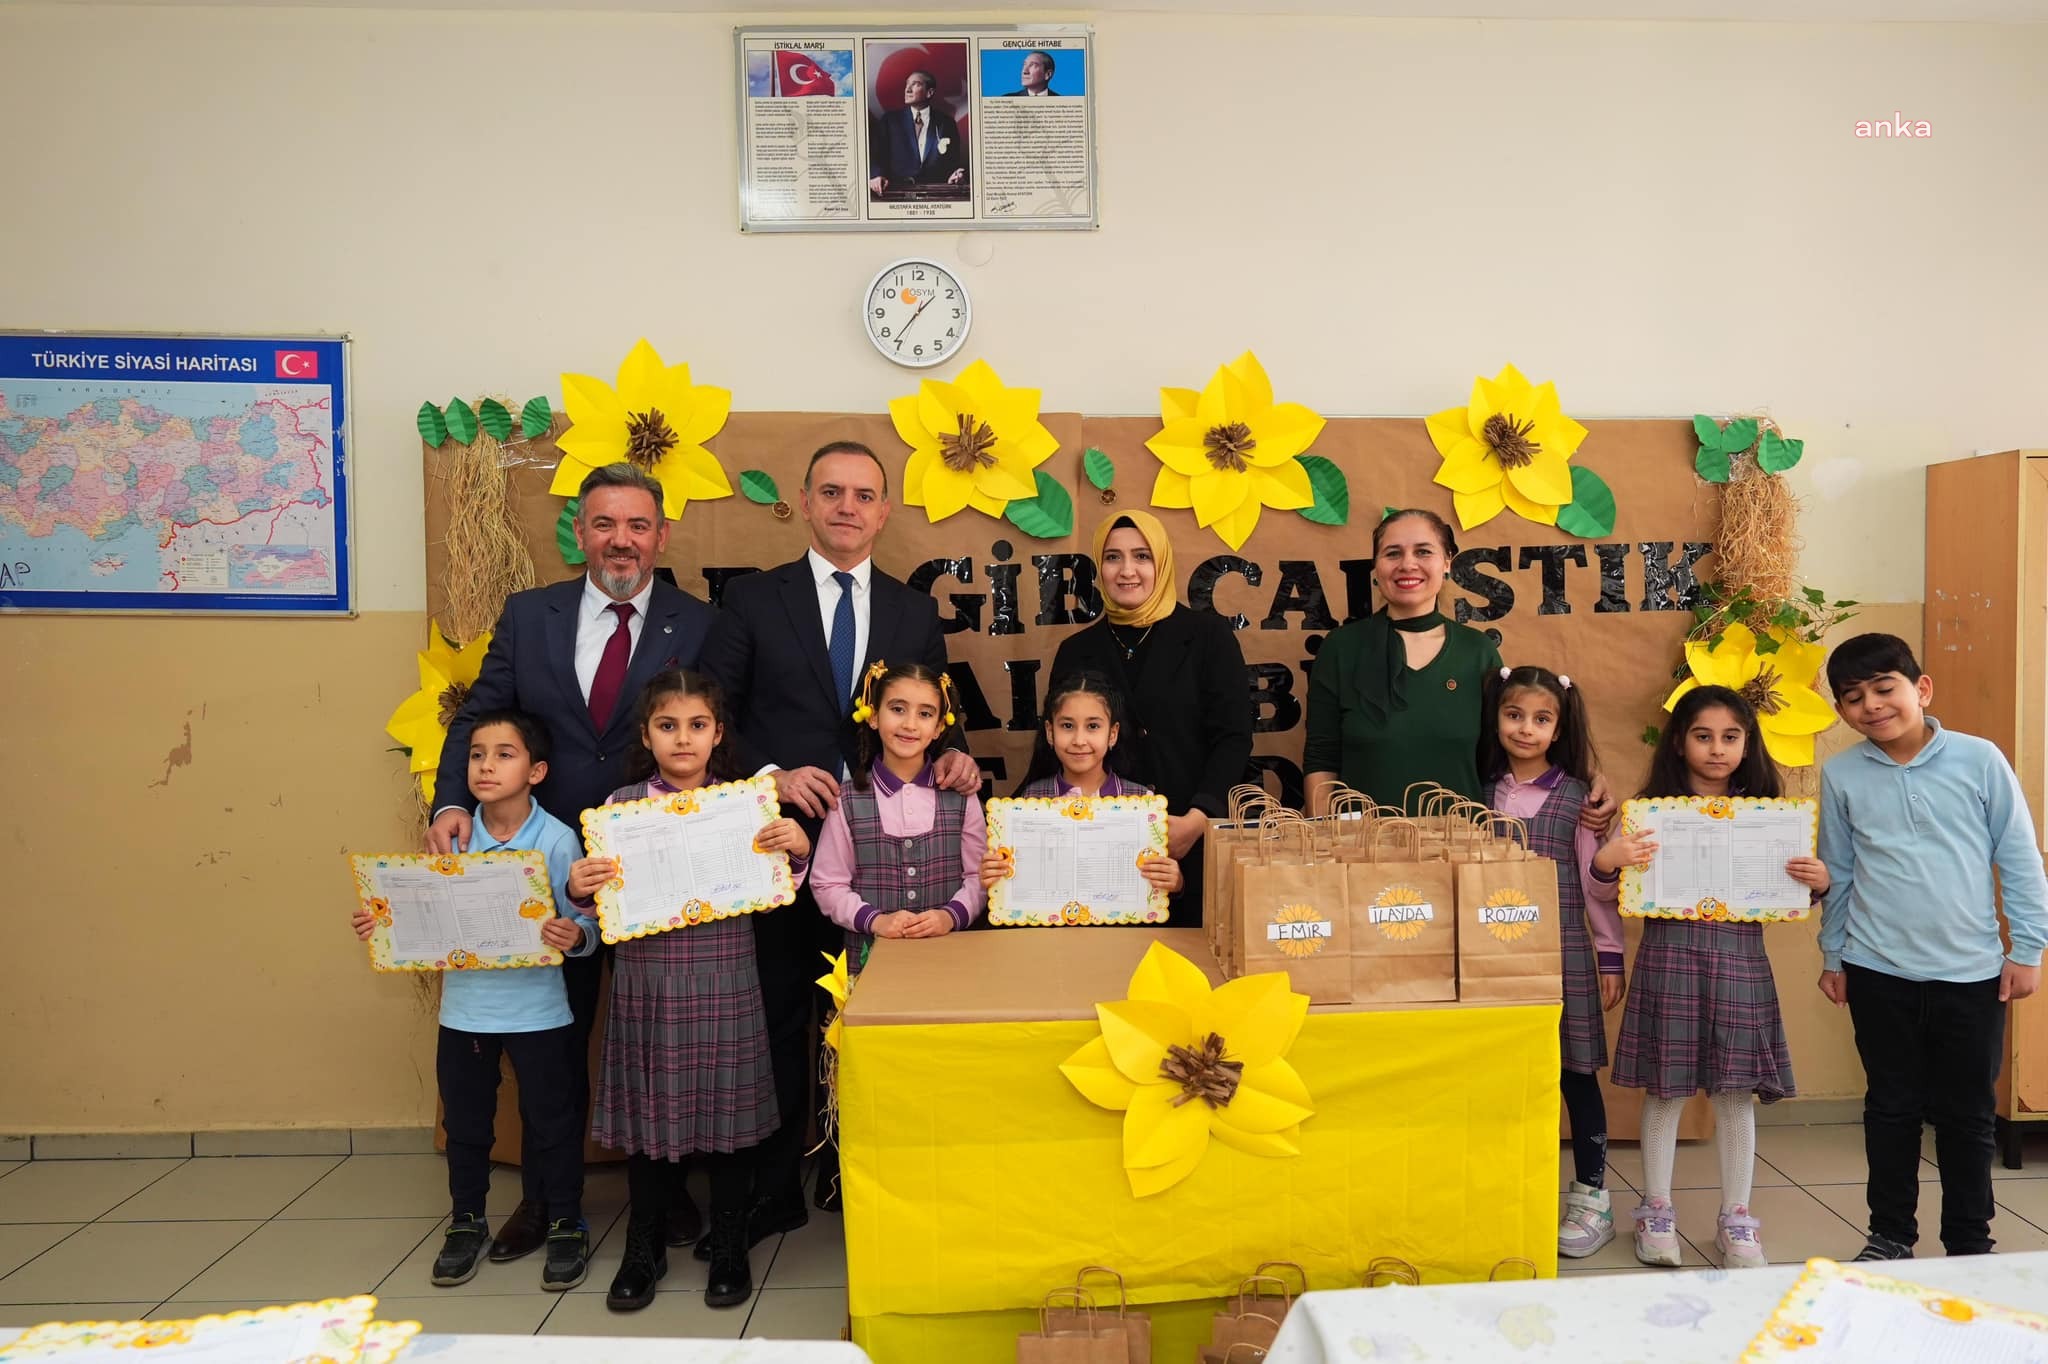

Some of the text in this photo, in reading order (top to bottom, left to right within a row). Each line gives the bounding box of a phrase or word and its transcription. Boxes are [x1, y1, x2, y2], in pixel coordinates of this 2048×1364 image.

[895, 275, 903, 286] 11
[912, 270, 925, 281] 12
[882, 288, 896, 299] 10
[945, 289, 955, 300] 2
[875, 308, 885, 319] 9
[951, 308, 961, 319] 3
[881, 327, 891, 338] 8
[946, 327, 955, 338] 4
[894, 340, 903, 351] 7
[913, 344, 923, 356] 6
[933, 340, 943, 351] 5
[31, 350, 257, 372] TÜRKİYE SİYASİ HARİTASI
[1373, 906, 1427, 924] İLAYDA
[1278, 921, 1324, 940] EMİR
